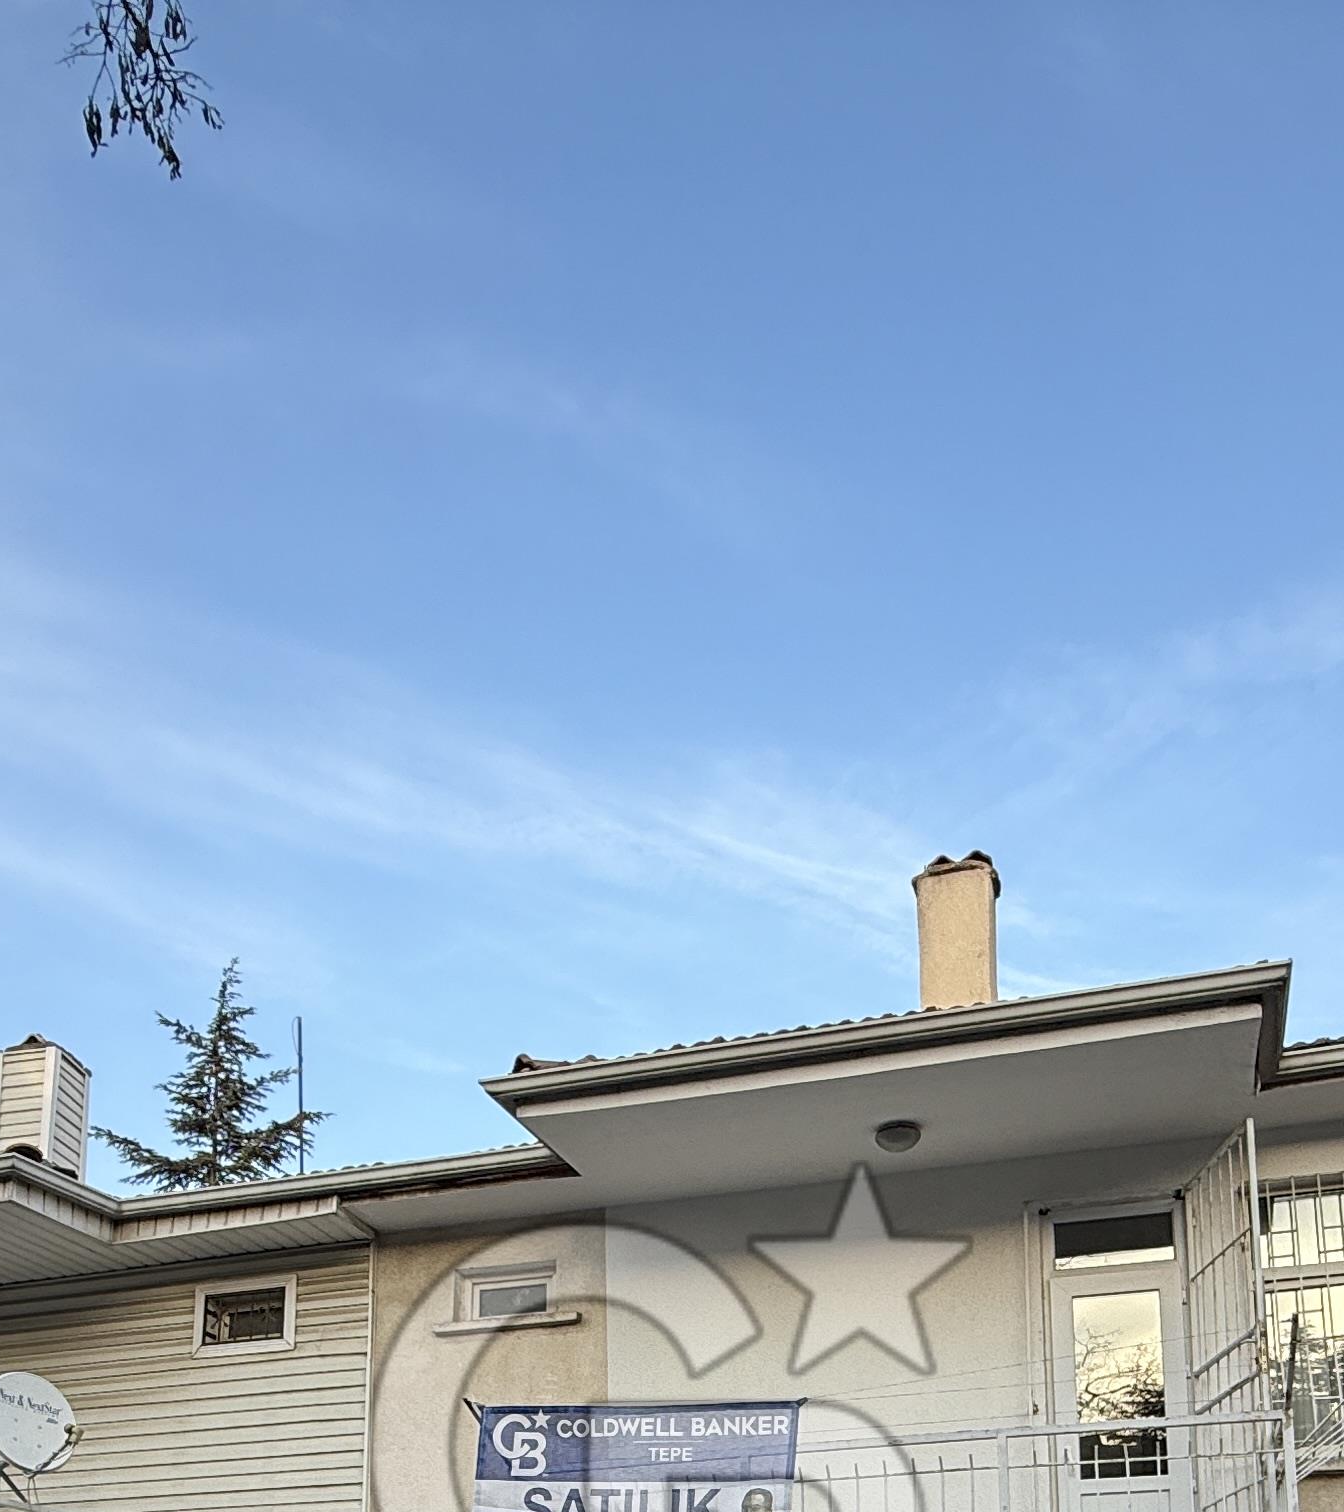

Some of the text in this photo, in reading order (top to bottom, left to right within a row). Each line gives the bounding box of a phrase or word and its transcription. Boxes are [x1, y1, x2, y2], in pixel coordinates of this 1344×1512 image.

[556, 1415, 789, 1438] COLDWELL BANKER
[648, 1447, 694, 1462] TEPE
